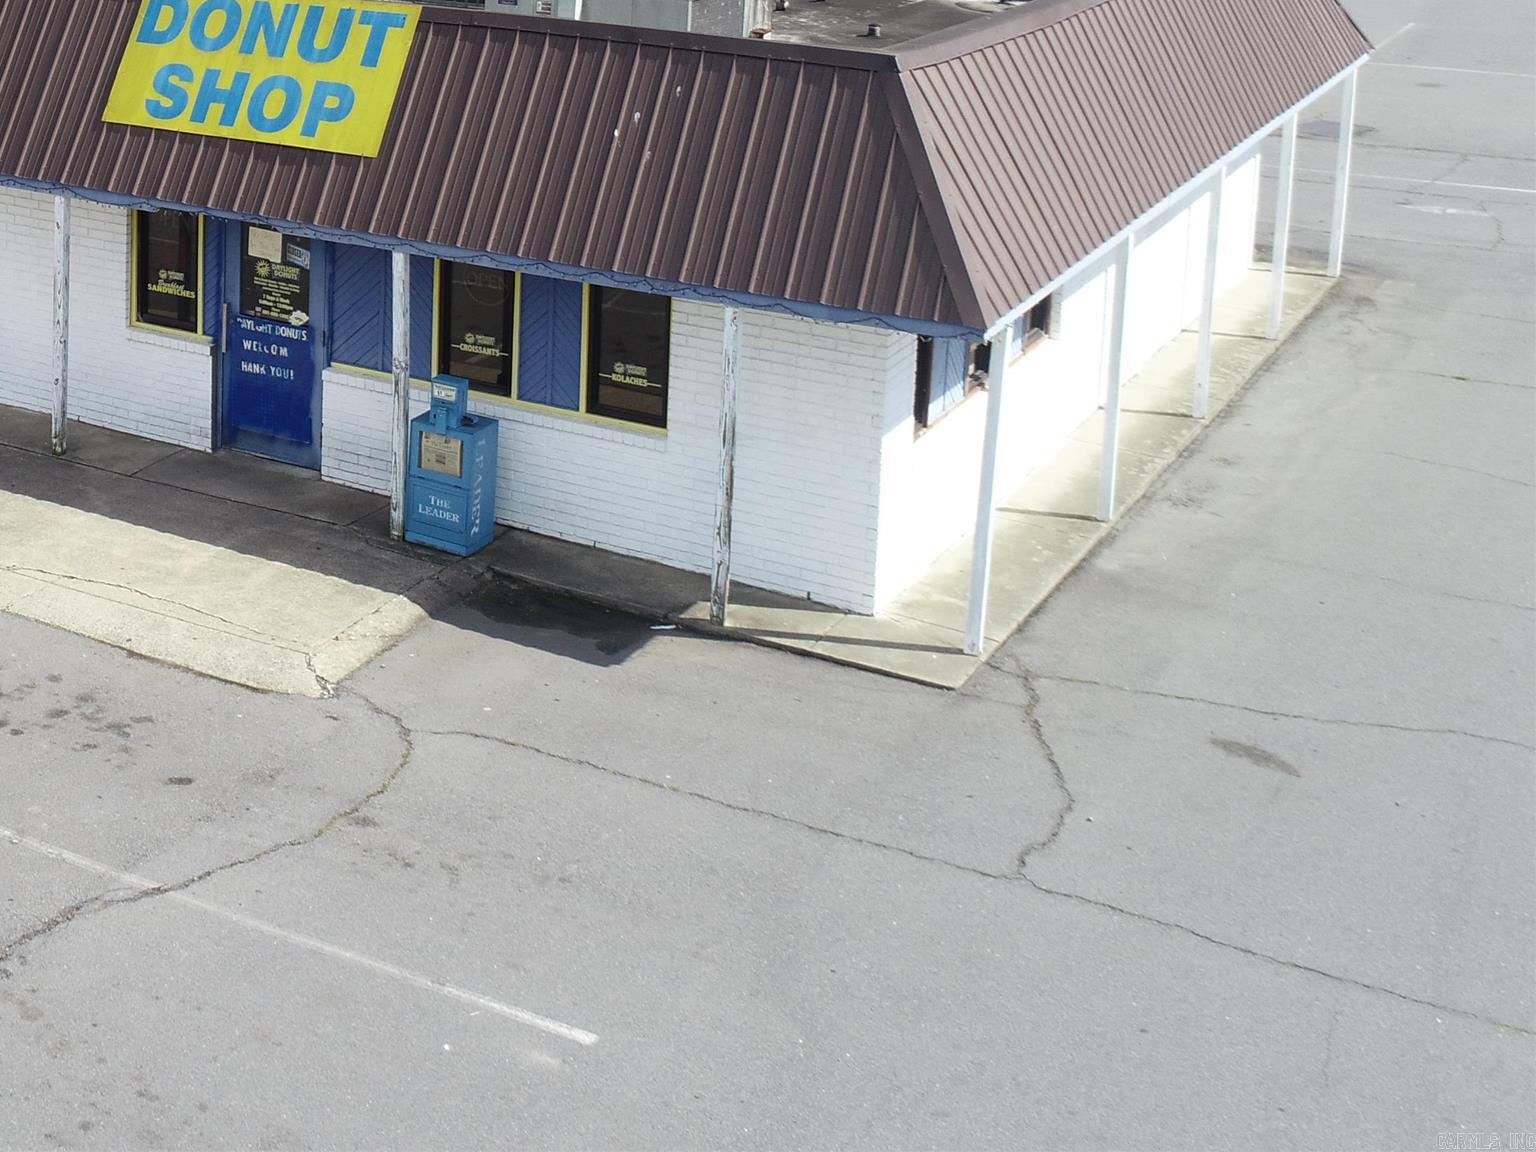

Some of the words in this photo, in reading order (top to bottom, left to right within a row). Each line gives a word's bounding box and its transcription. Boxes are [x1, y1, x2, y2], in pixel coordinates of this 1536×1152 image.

[145, 62, 355, 138] SHOP
[147, 283, 196, 299] SANDWICHES
[275, 325, 308, 341] DONUTS
[459, 343, 500, 357] CROISSANTS
[270, 366, 294, 380] YOU!
[611, 373, 648, 387] KOLACHES
[428, 495, 451, 509] THE
[418, 503, 460, 523] LEADER
